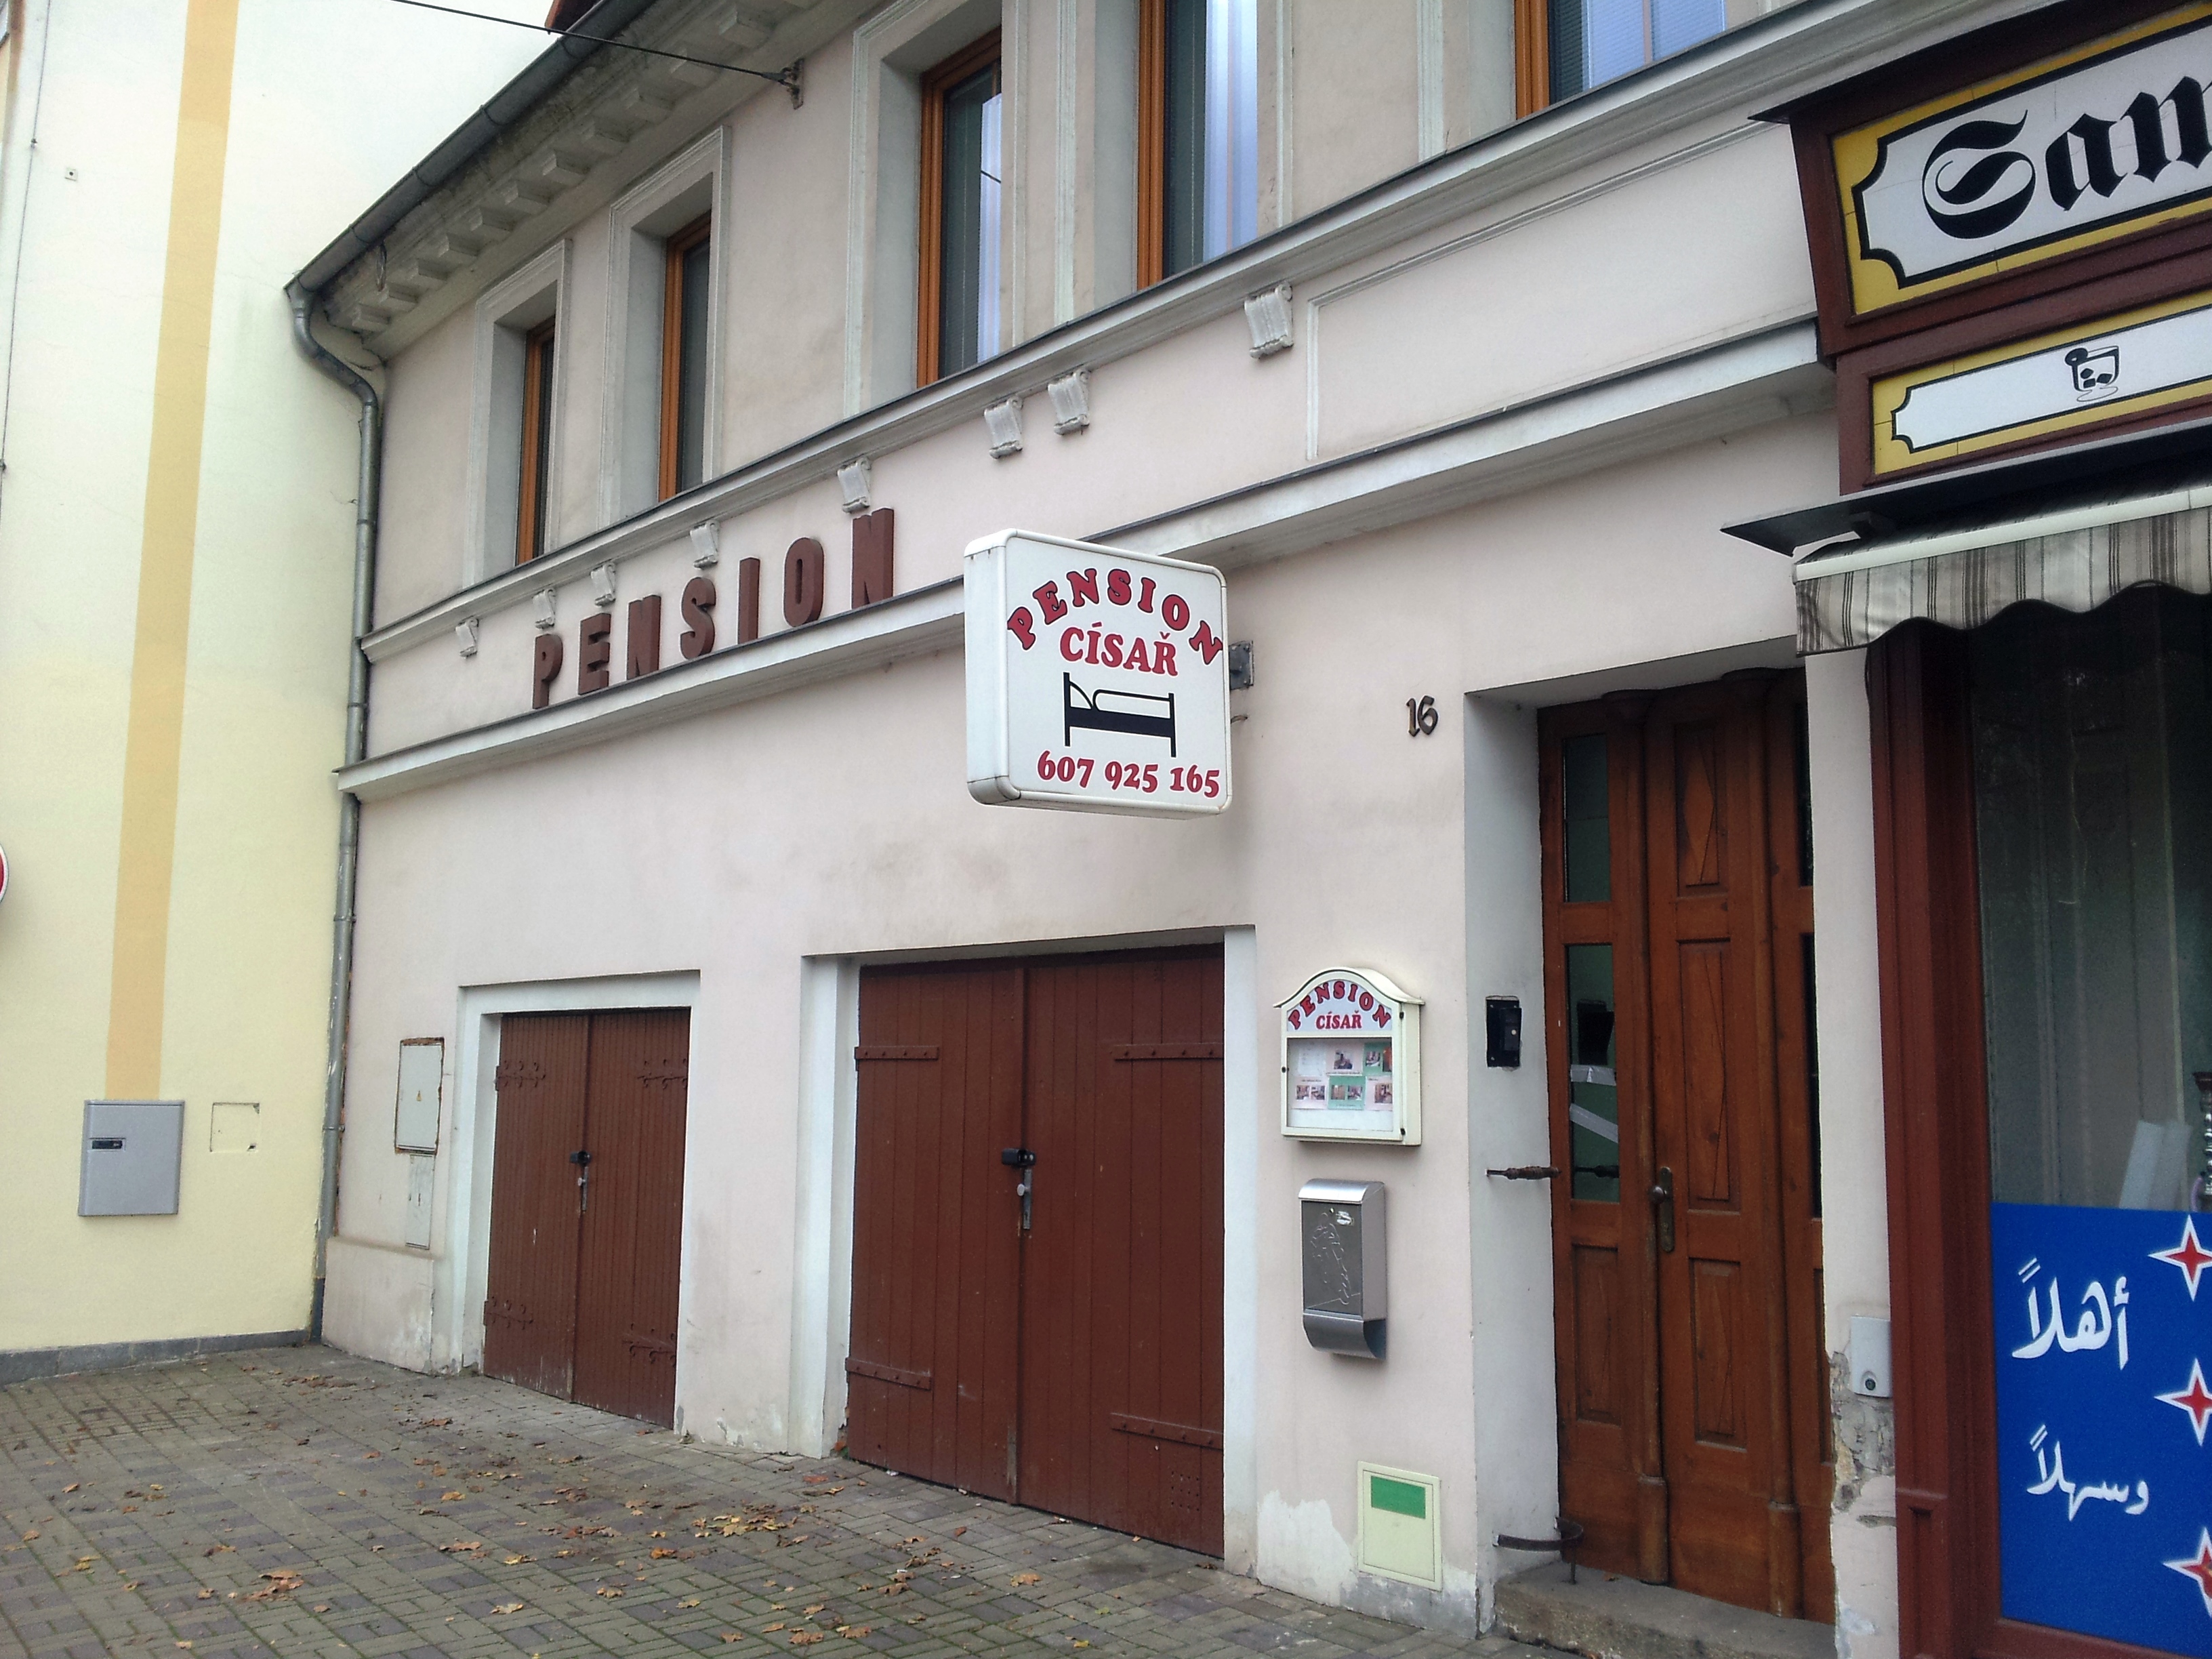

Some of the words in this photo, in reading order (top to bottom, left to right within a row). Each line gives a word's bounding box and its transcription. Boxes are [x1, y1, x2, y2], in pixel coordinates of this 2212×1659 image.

[533, 508, 895, 709] PENSION
[1007, 568, 1223, 665] PENSION
[1060, 621, 1178, 676] CÍSAŘ
[1406, 695, 1439, 737] 16
[1038, 750, 1094, 789] 607
[1105, 761, 1159, 793] 925
[1170, 764, 1220, 798] 165
[1288, 981, 1391, 1029] PENSION
[1316, 1010, 1362, 1029] CÍSAŘ
